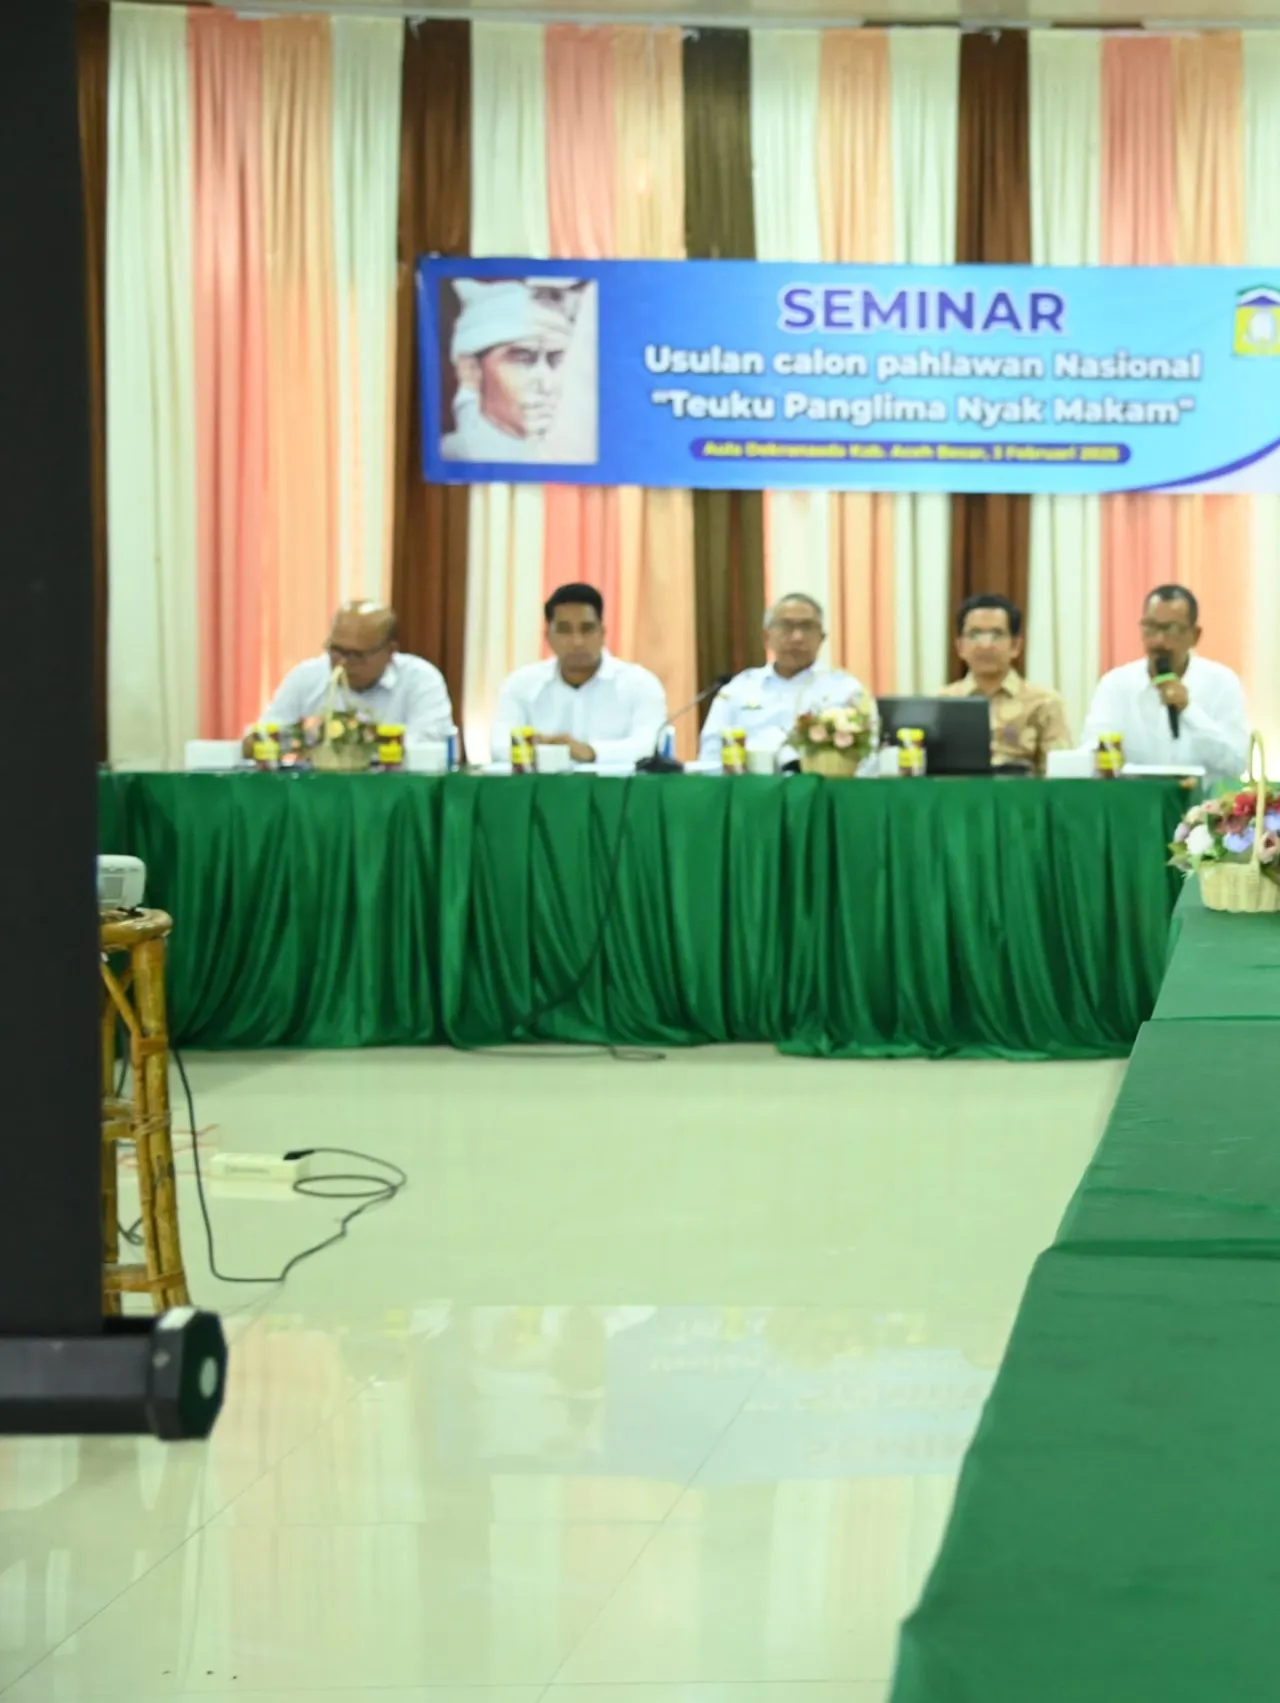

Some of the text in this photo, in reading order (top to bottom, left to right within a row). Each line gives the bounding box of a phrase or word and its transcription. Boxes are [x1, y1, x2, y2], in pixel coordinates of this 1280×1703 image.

[783, 287, 1064, 332] SEMINAR
[644, 344, 1201, 383] Usulan calon pahlawan Nasional
[784, 391, 946, 427] Panglima
[957, 395, 1045, 429] Nyak
